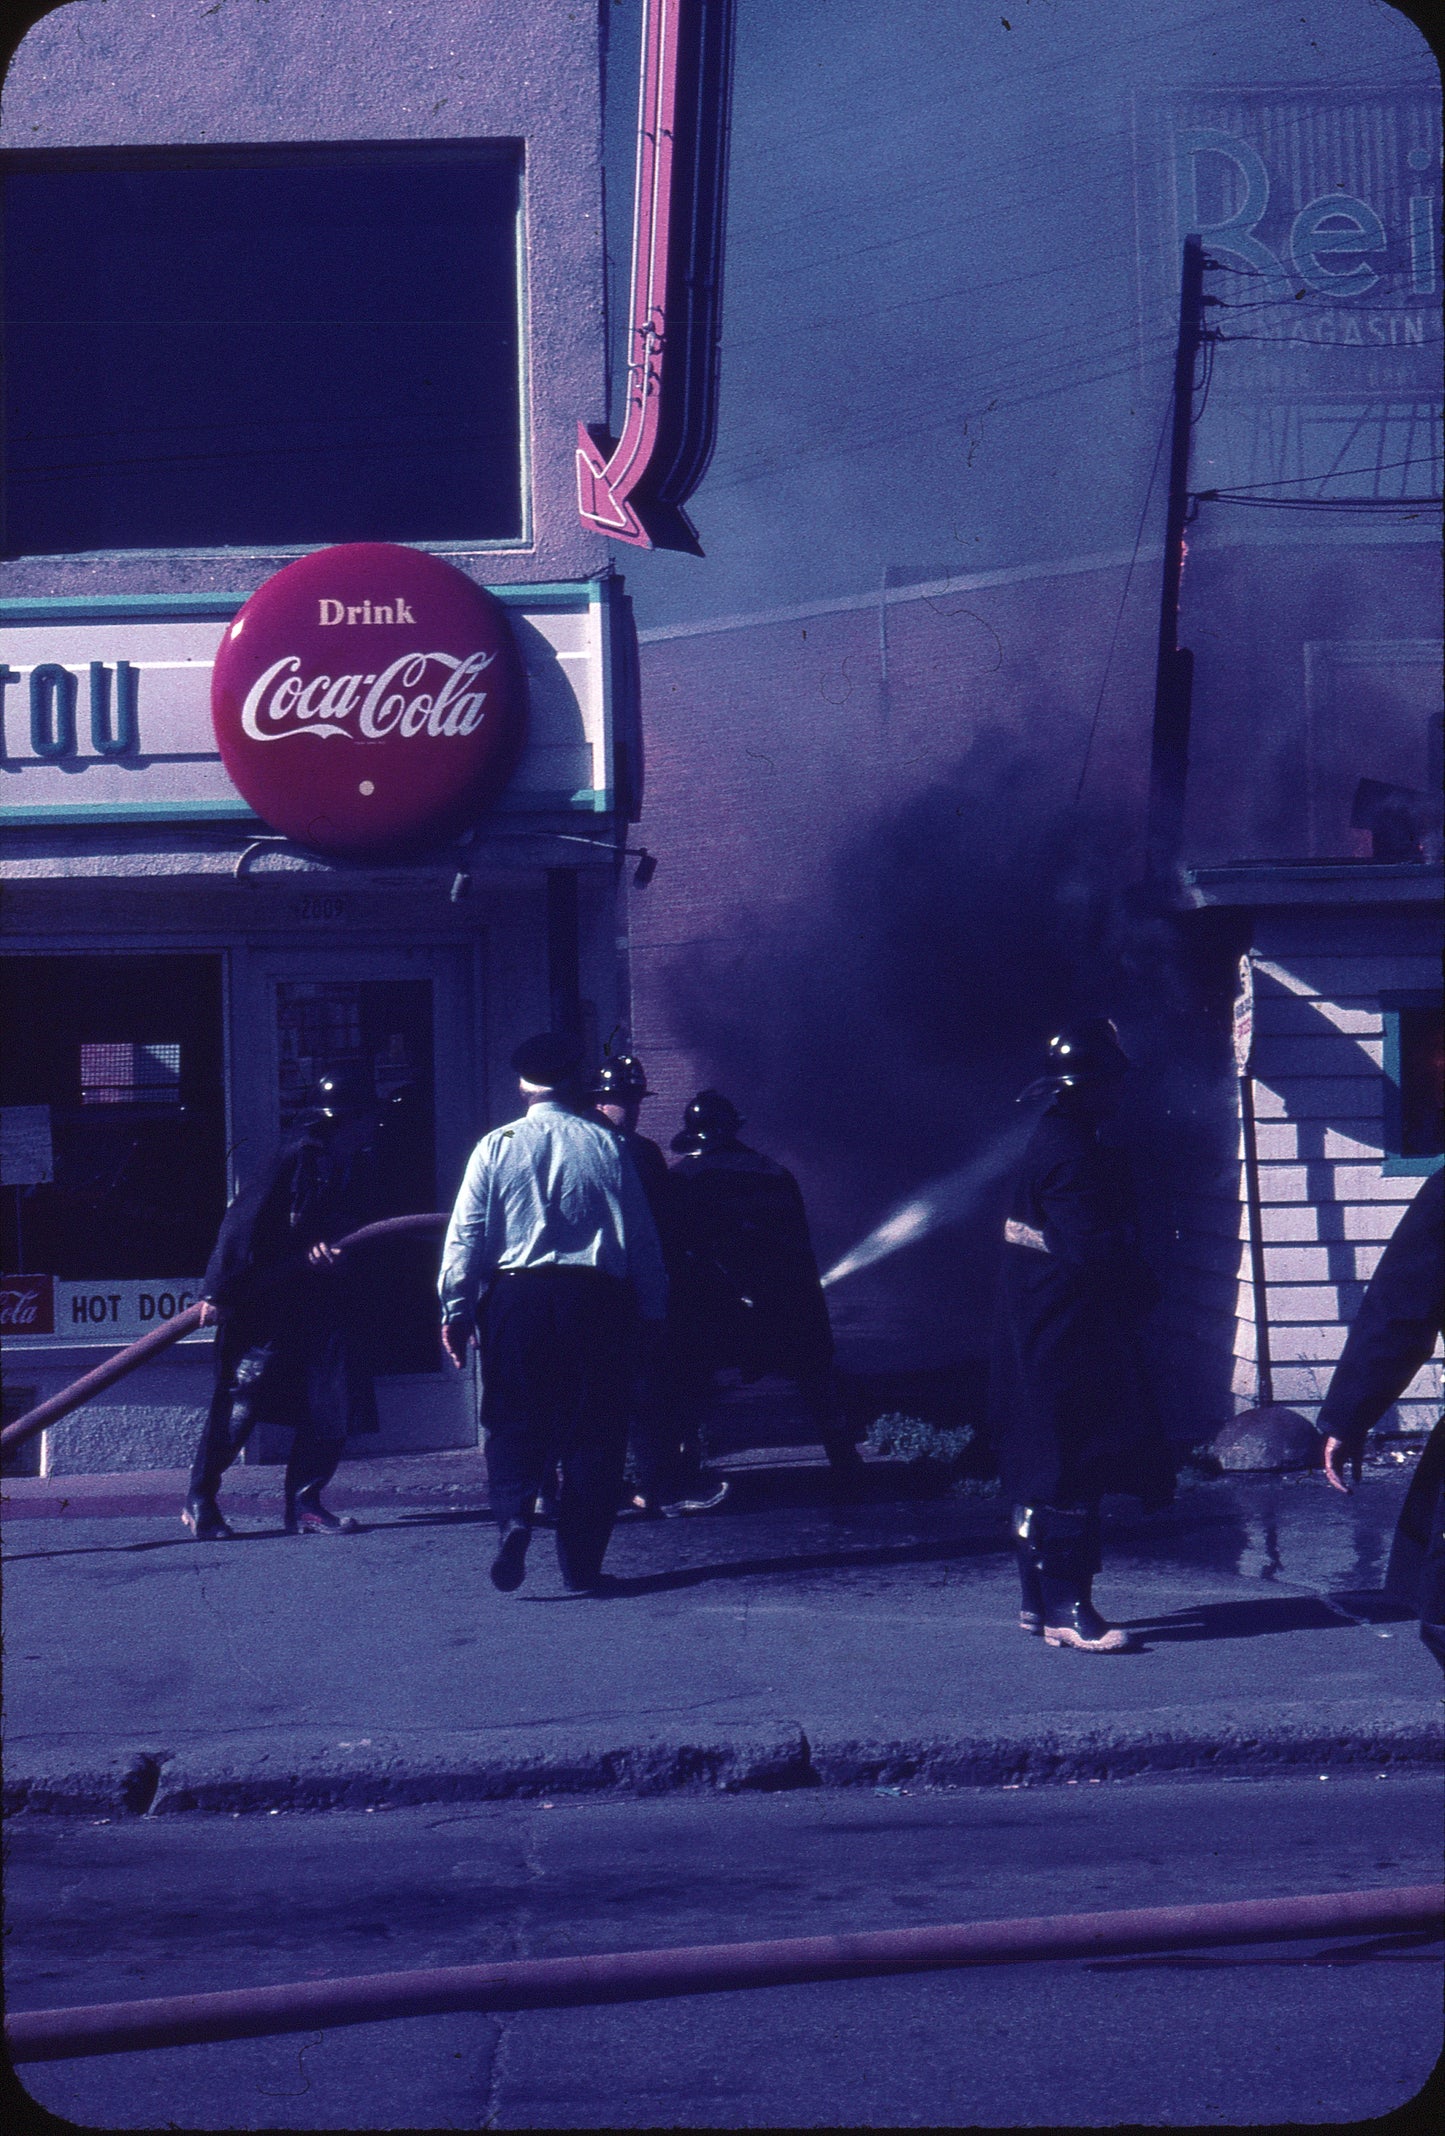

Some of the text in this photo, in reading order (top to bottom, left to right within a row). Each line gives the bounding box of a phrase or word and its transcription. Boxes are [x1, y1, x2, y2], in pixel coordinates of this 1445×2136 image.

[318, 598, 417, 626] Drink
[241, 651, 496, 741] Coca-Cola
[72, 1295, 121, 1323] HOT
